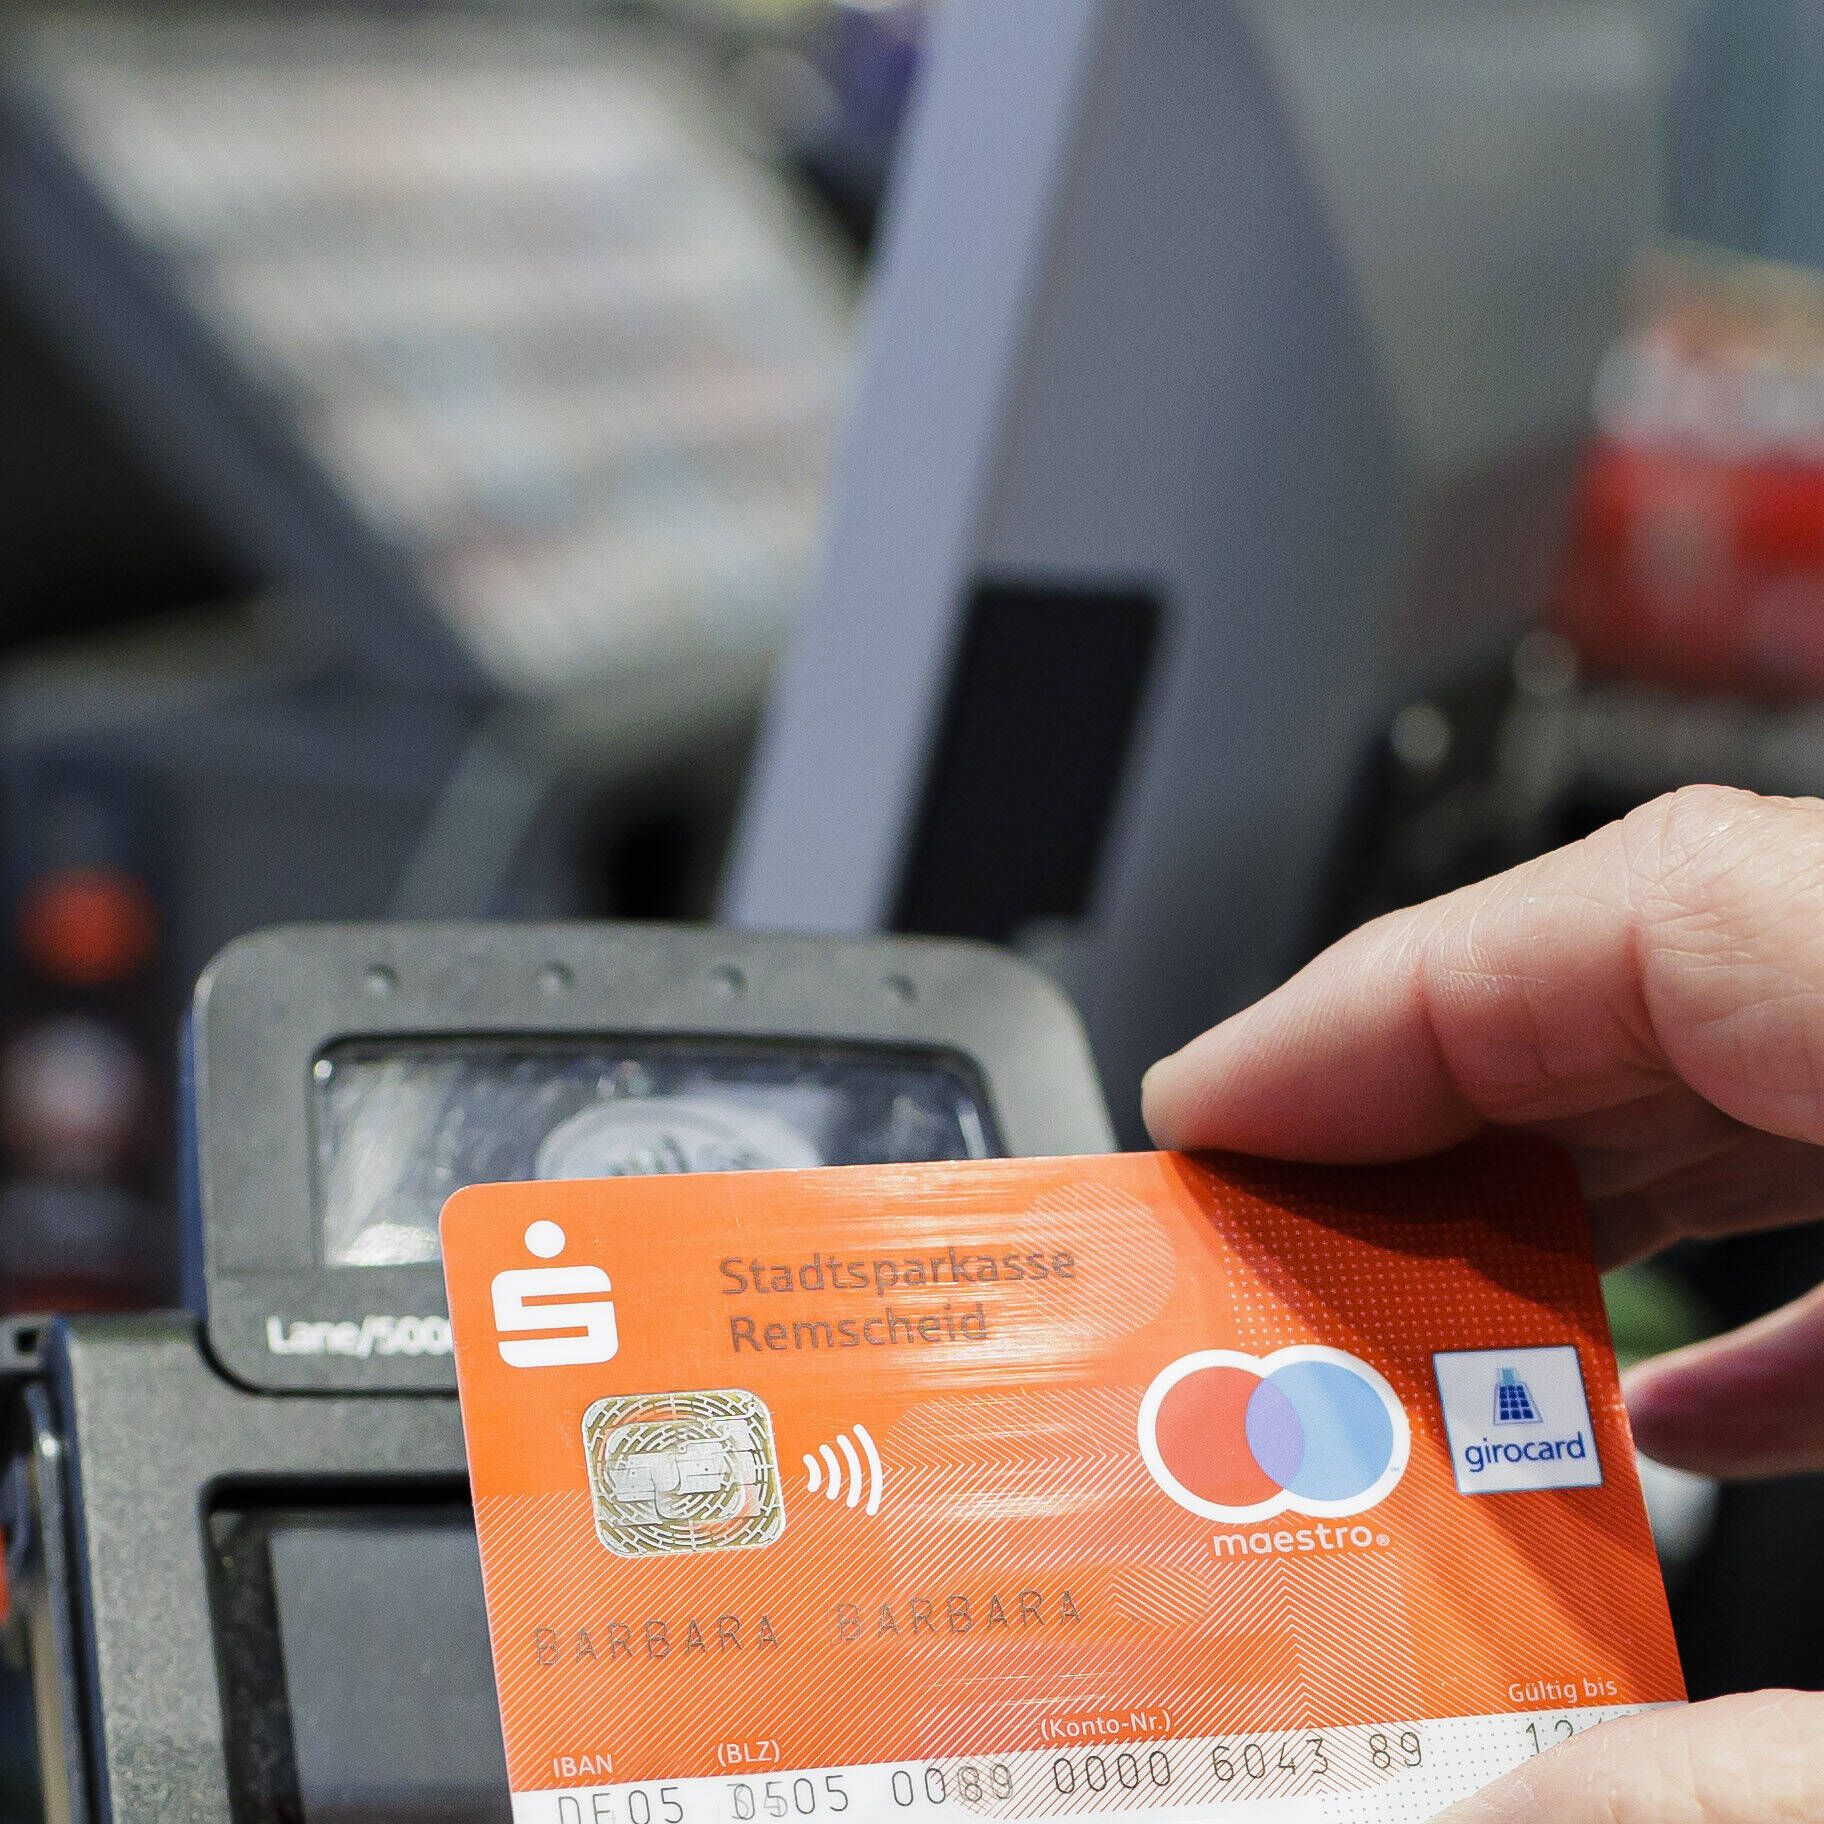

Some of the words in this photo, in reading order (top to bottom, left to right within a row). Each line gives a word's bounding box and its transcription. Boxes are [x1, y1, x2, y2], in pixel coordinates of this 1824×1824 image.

[719, 1245, 1077, 1298] Stadtsparkasse
[266, 1314, 455, 1358] Lane/500
[729, 1302, 989, 1355] Remscheid
[1465, 1432, 1586, 1472] girocard
[534, 1614, 778, 1666] BARBARA
[836, 1588, 1082, 1644] BARBARA
[1508, 1679, 1578, 1704] Gültig
[1583, 1677, 1618, 1698] bis
[1040, 1710, 1172, 1741] (Konto-Nr.)
[552, 1752, 613, 1778] IBAN
[716, 1739, 781, 1767] (BLZ)
[1053, 1749, 1172, 1796] 0000
[1212, 1736, 1331, 1784] 6043
[1370, 1730, 1422, 1771] 89
